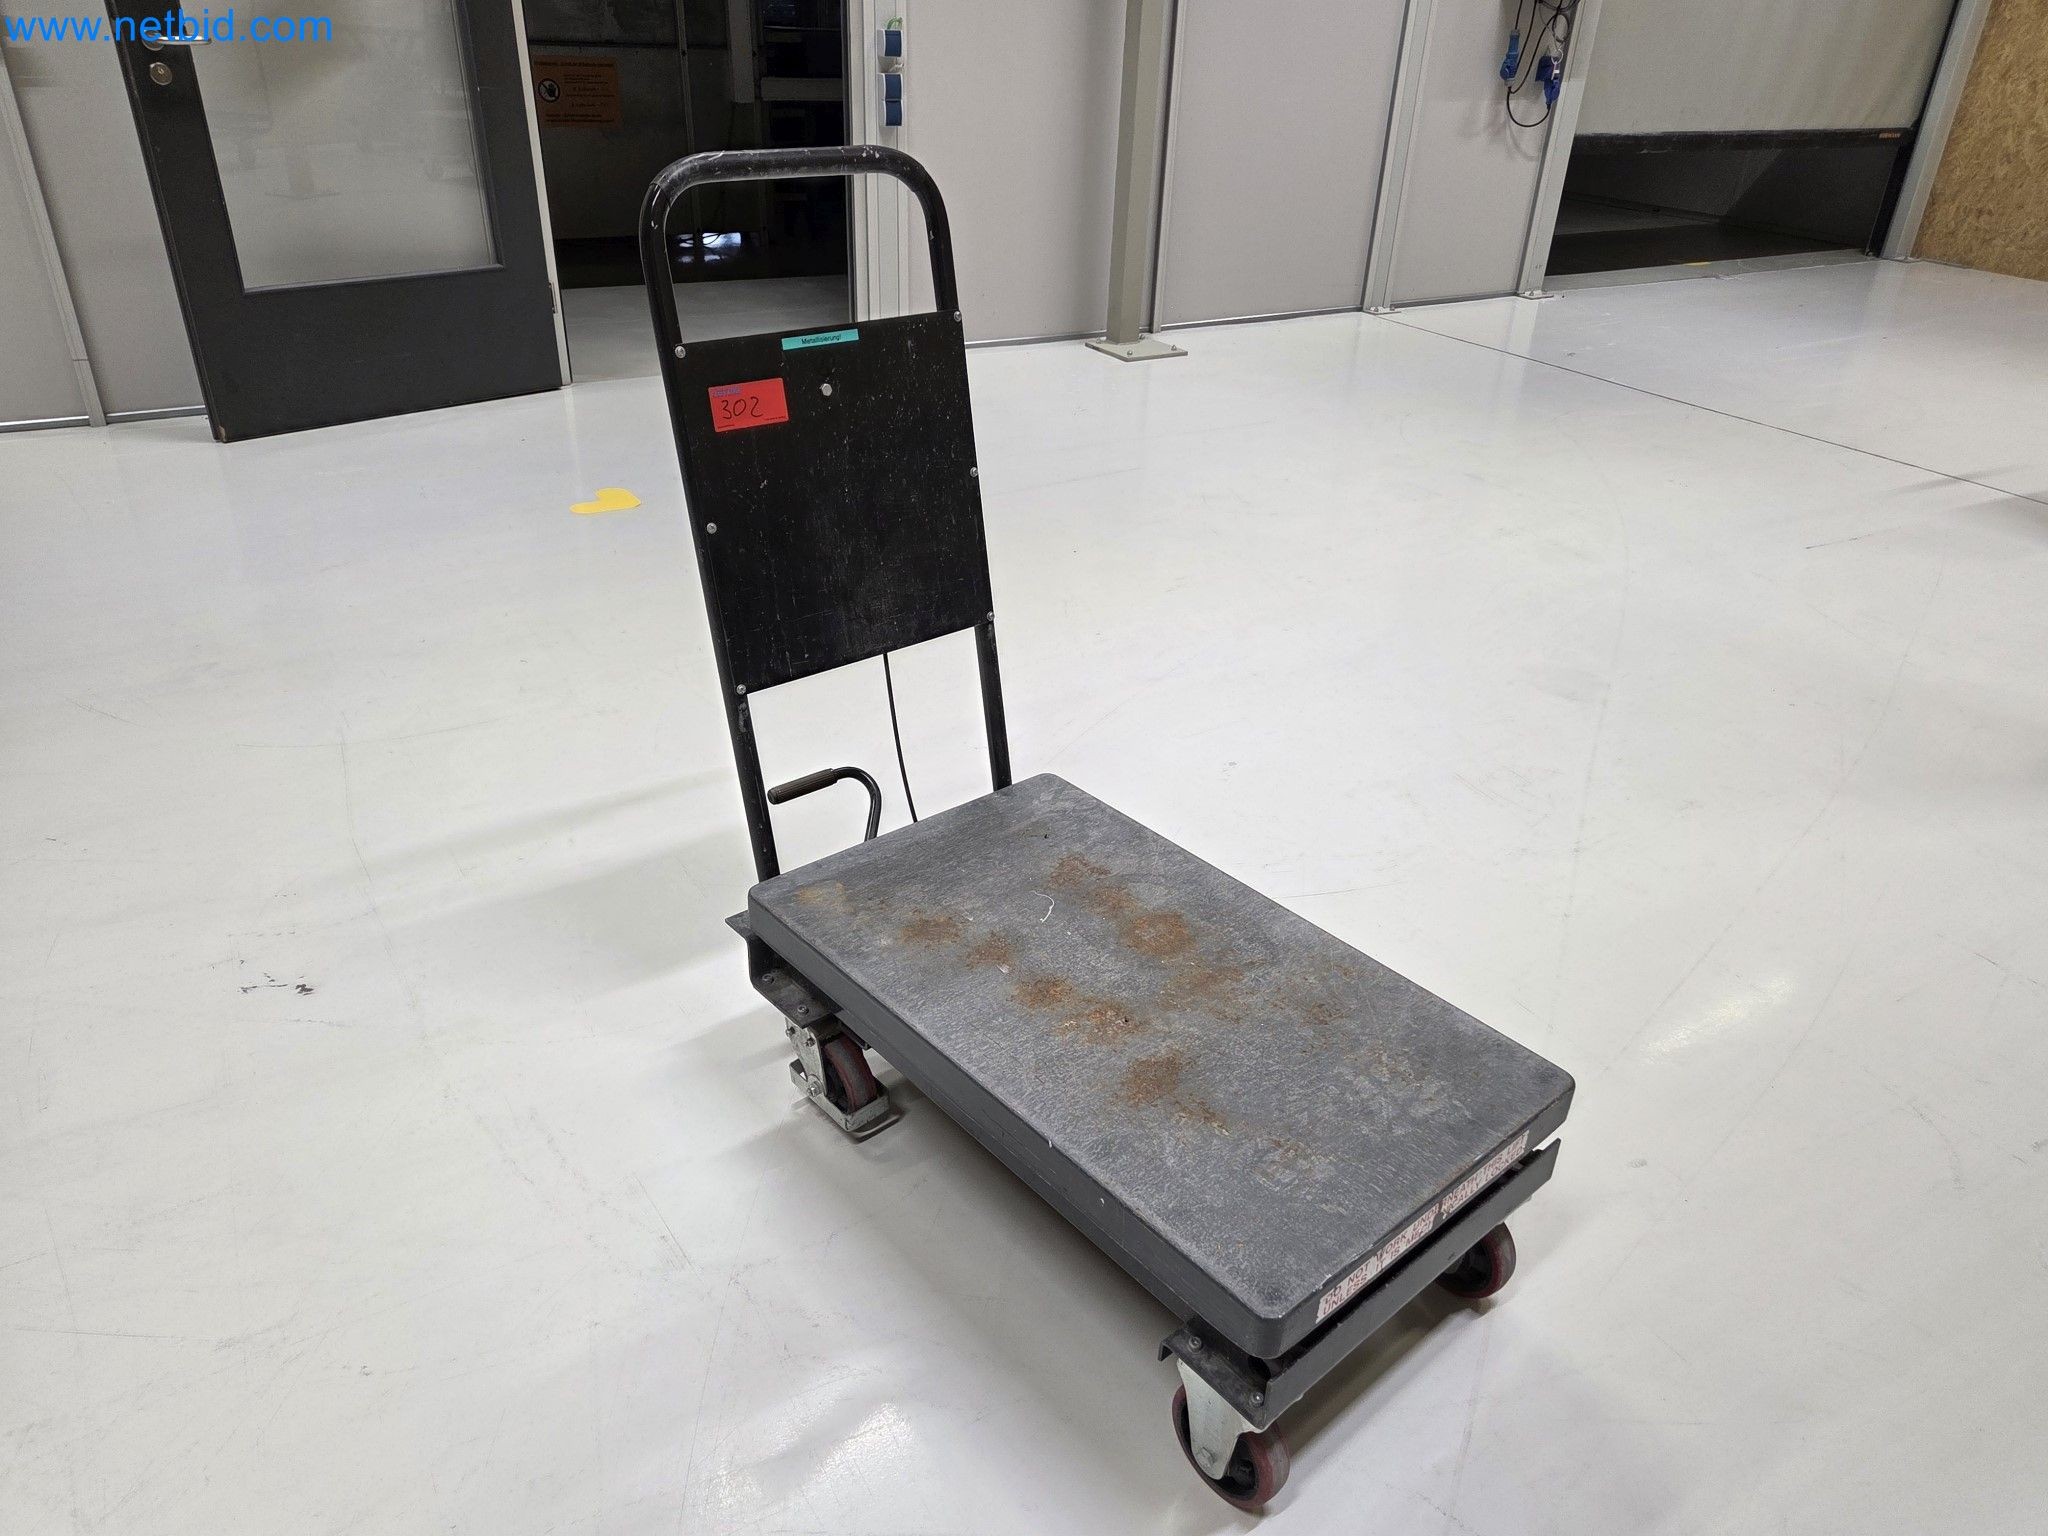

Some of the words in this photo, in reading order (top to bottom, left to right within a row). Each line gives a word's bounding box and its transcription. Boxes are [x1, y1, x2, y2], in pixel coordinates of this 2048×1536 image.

[721, 397, 764, 420] 302
[1324, 1285, 1342, 1305] DO
[1347, 1262, 1370, 1286] NOT
[1376, 1232, 1407, 1262] WORK
[1411, 1173, 1479, 1232] UNDENEATH
[1483, 1152, 1503, 1175] THIS
[1322, 1273, 1368, 1315] UNLESS
[1390, 1246, 1401, 1260] IS
